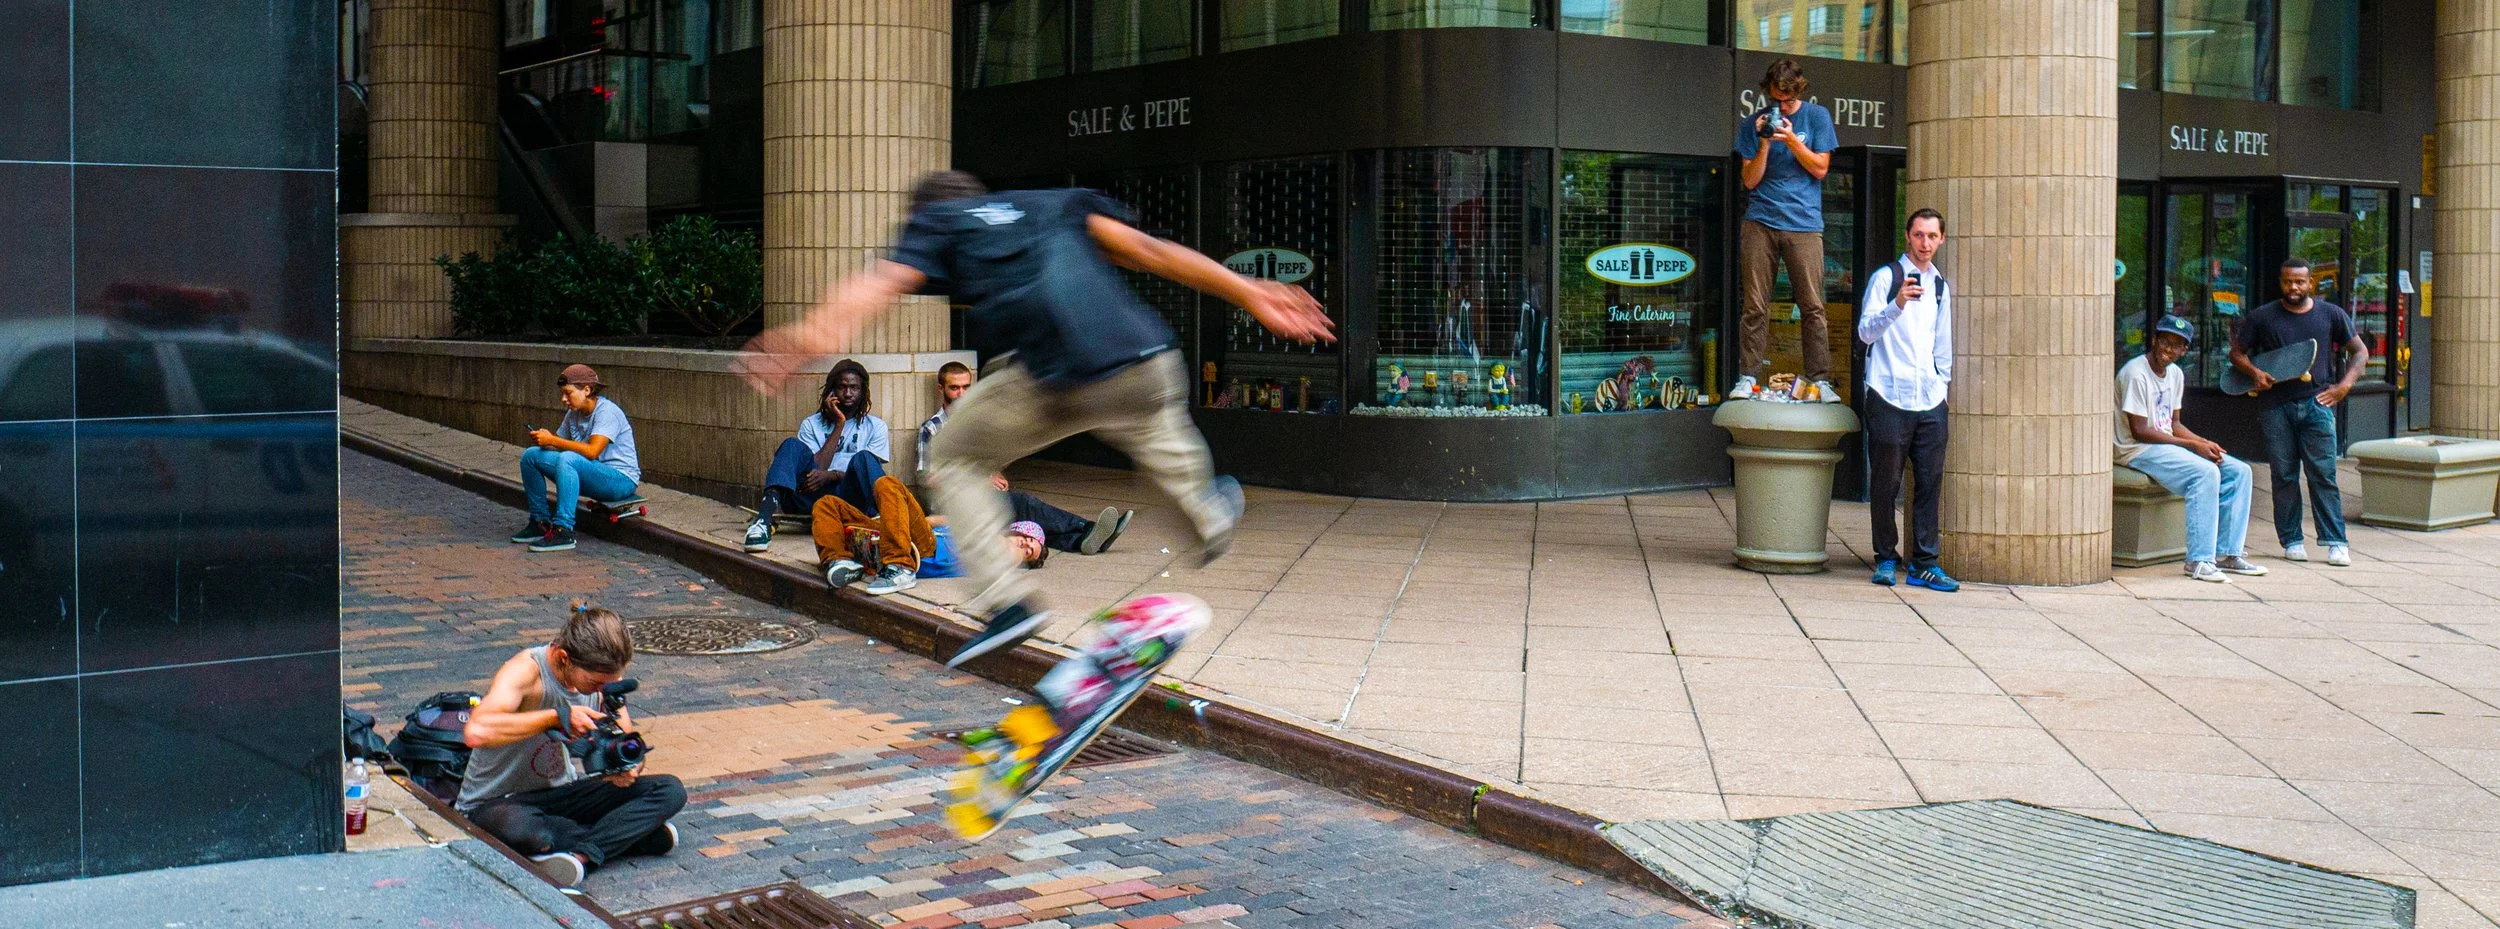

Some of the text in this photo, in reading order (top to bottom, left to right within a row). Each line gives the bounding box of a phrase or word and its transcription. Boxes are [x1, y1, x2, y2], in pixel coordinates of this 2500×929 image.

[1068, 97, 1191, 137] SALE & PEPE
[1834, 97, 1886, 128] PEPE
[2170, 124, 2269, 156] SALE & PEPE
[1277, 262, 1307, 274] PEPE
[1596, 259, 1688, 272] SALE PEPE
[1608, 304, 1675, 327] Fine Catering
